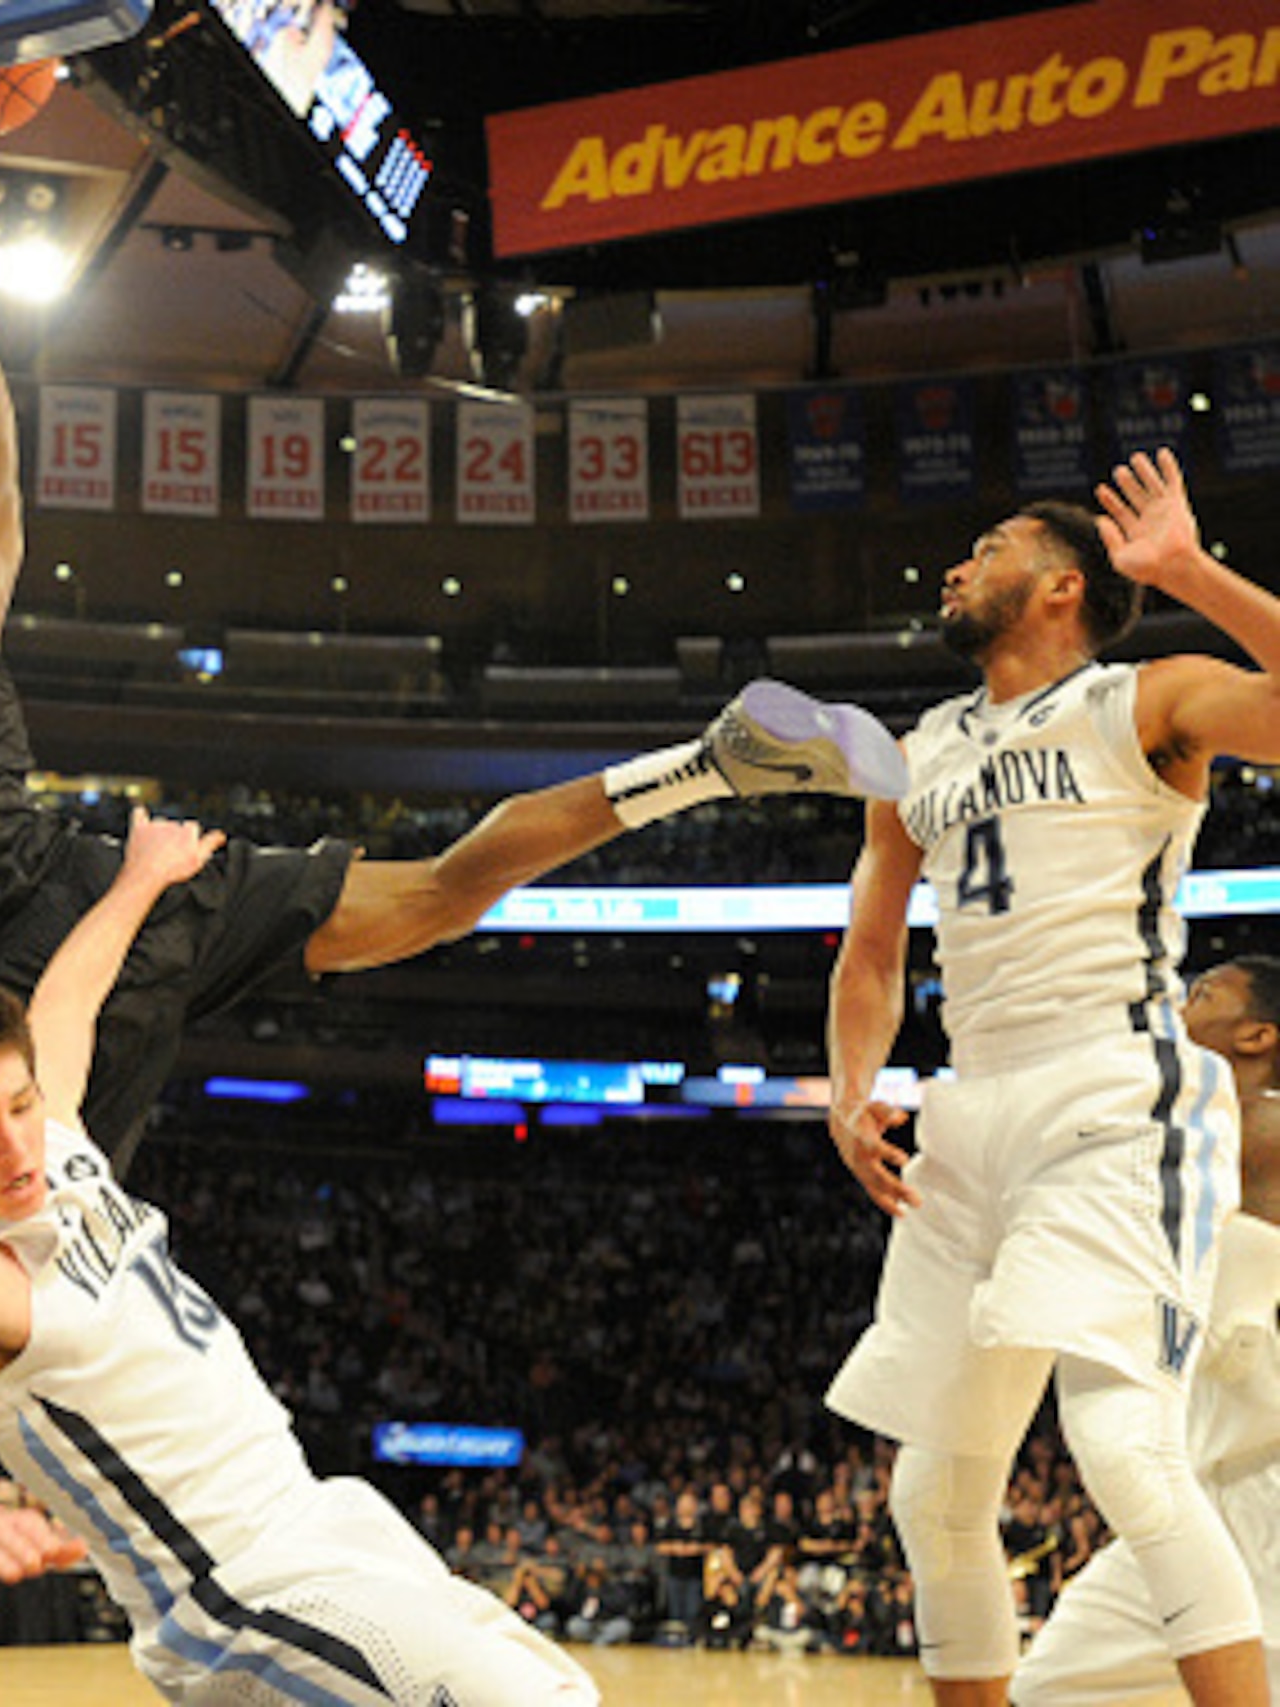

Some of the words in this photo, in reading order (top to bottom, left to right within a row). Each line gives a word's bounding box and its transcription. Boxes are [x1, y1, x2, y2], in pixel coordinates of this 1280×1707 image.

[541, 98, 888, 210] Advance
[892, 53, 1127, 150] Auto
[53, 424, 102, 468] 15
[157, 428, 207, 474] 15
[261, 434, 311, 478] 19
[360, 437, 422, 482] 22
[464, 438, 525, 483] 24
[577, 435, 640, 482] 33
[681, 430, 755, 477] 613
[957, 812, 1016, 917] 4
